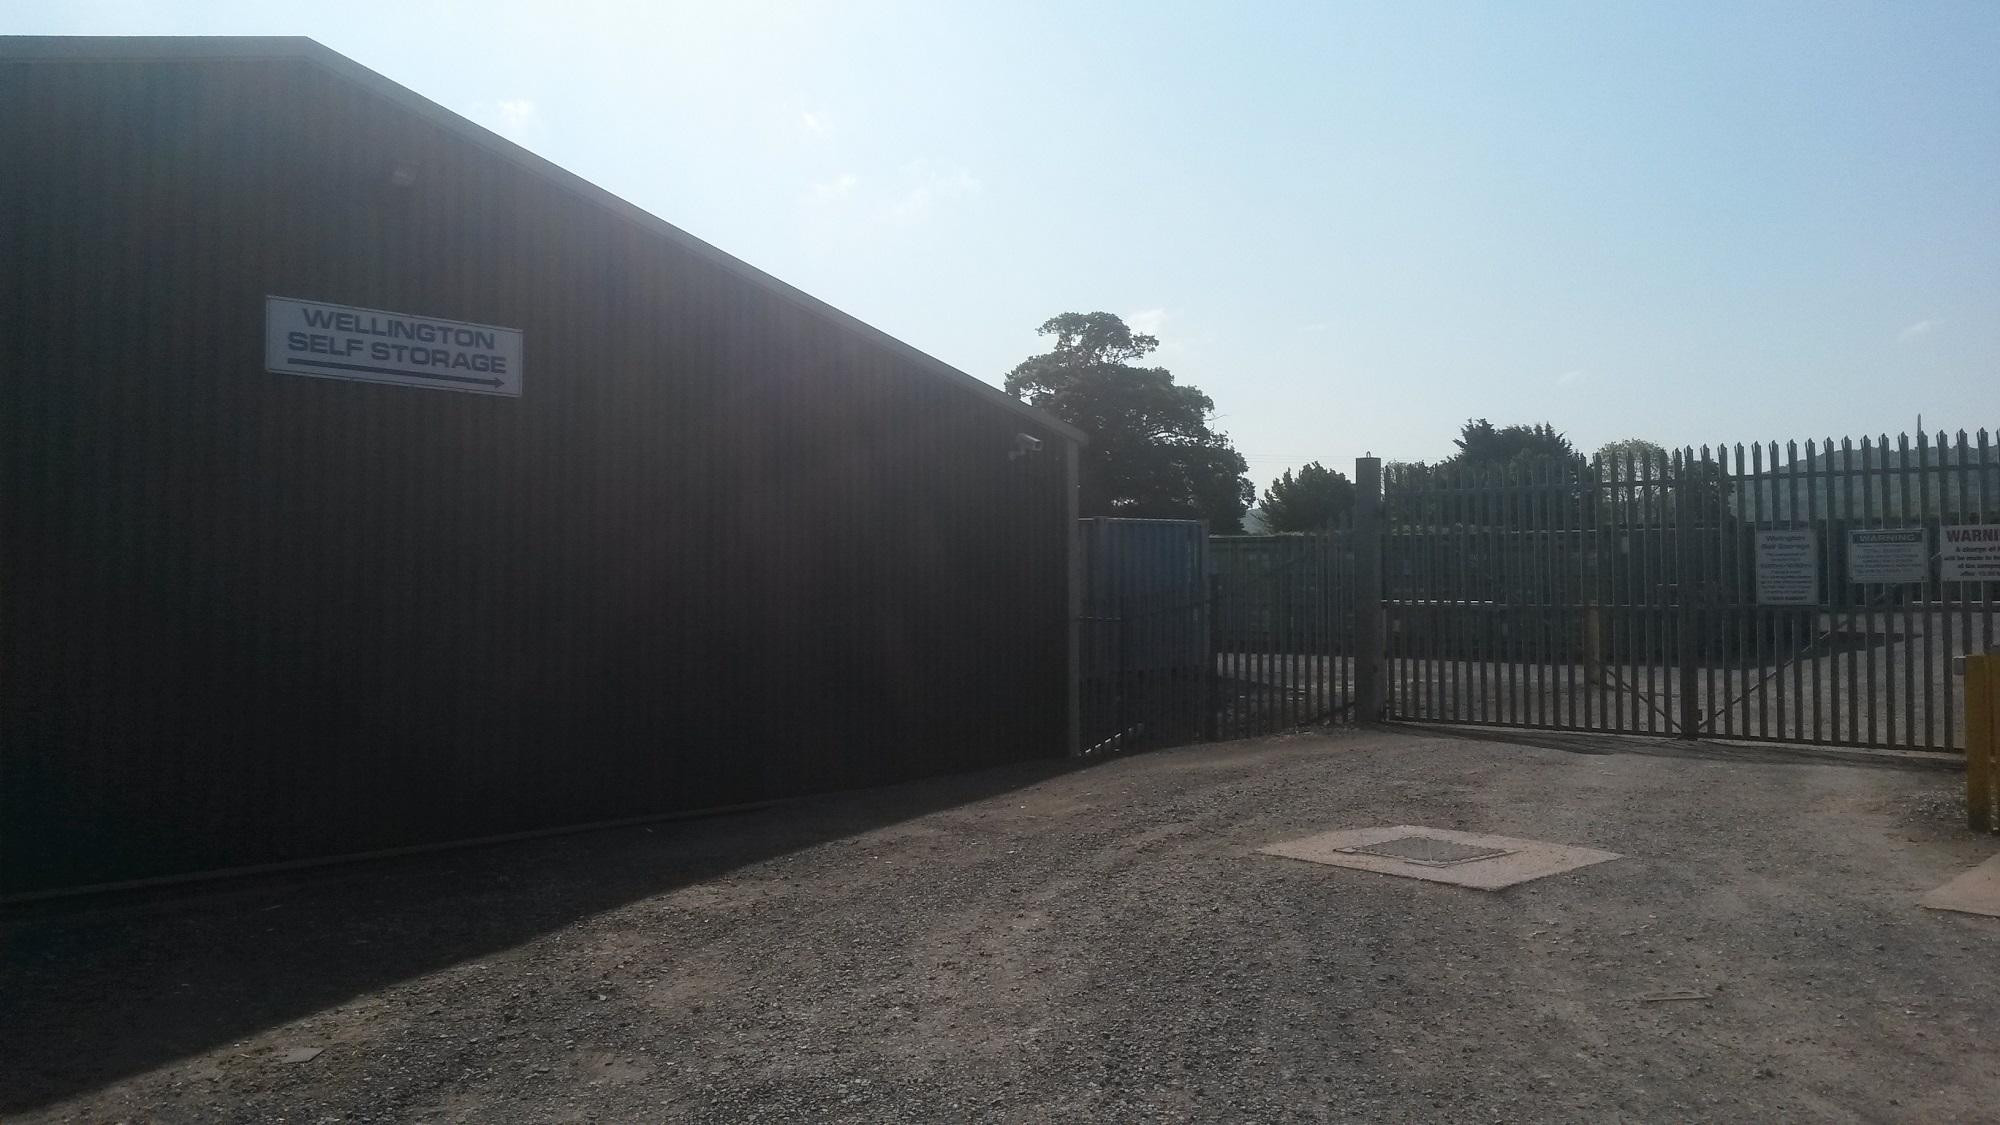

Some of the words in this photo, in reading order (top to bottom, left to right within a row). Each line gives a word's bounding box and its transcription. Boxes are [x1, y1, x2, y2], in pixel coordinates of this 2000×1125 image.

[302, 307, 495, 349] WELLINGTON
[287, 331, 364, 357] SELF
[371, 341, 507, 374] STORAGE
[1859, 533, 1916, 542] WARNING
